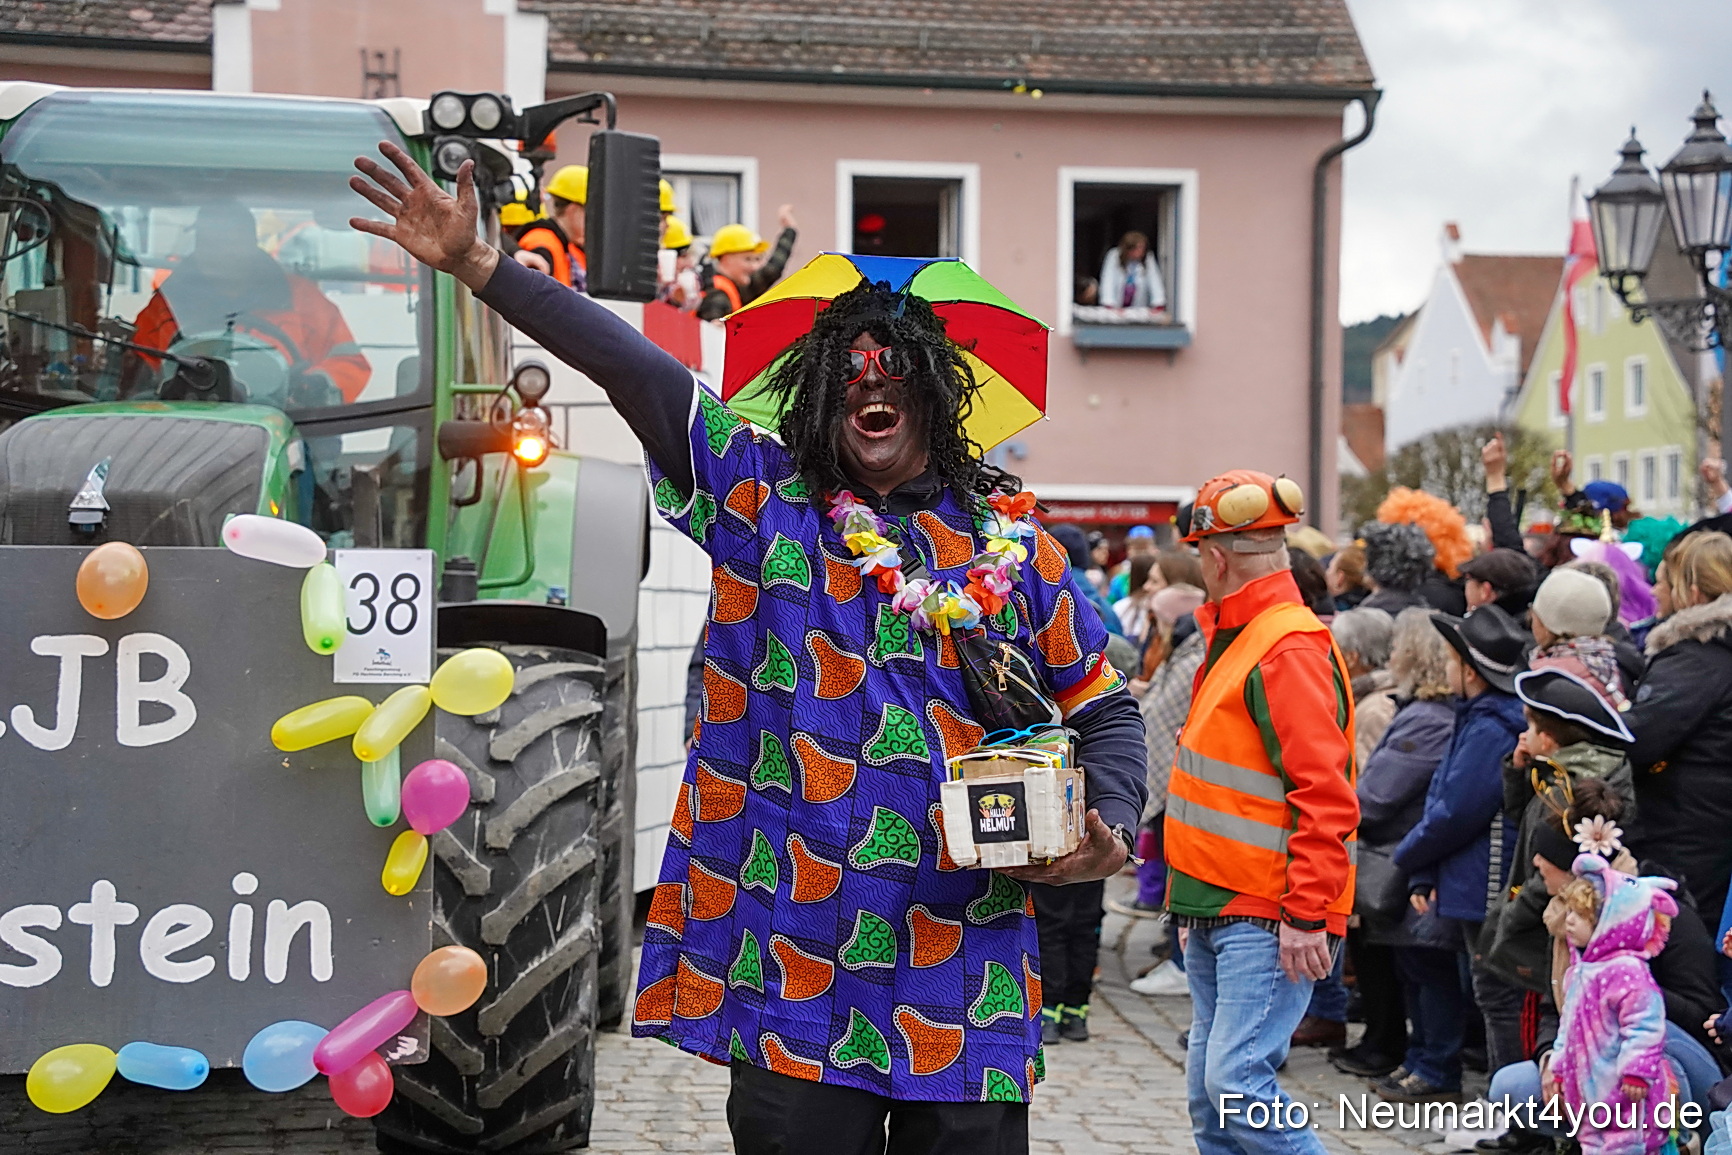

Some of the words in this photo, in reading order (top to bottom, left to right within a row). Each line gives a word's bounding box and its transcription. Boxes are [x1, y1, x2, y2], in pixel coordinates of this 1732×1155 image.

[346, 572, 421, 635] 38
[0, 632, 197, 751] JB
[979, 816, 1016, 833] HELMUT
[0, 871, 334, 988] stein
